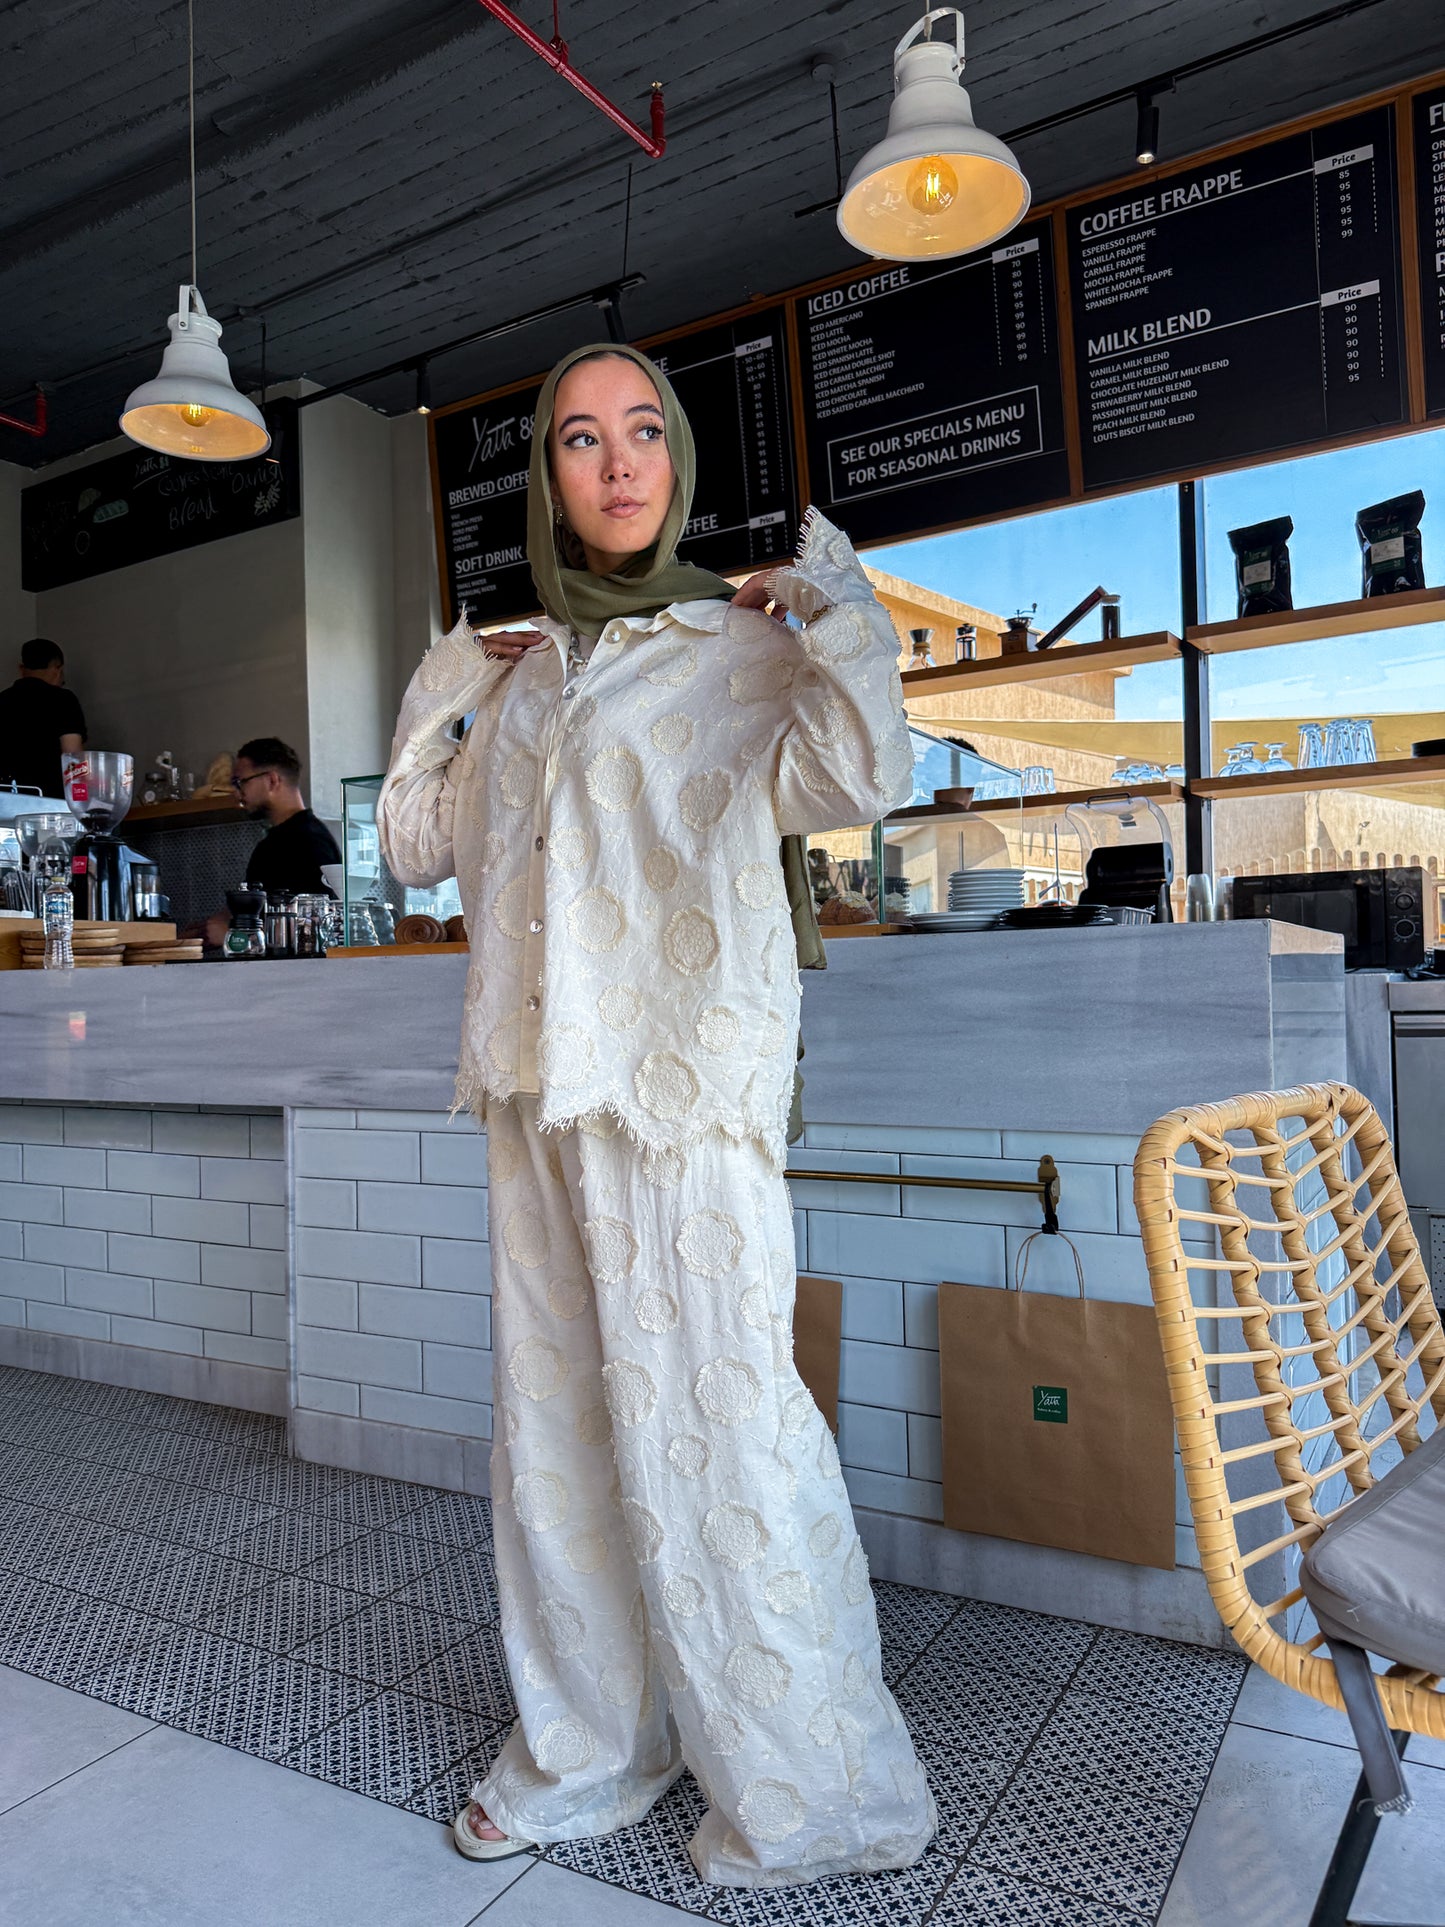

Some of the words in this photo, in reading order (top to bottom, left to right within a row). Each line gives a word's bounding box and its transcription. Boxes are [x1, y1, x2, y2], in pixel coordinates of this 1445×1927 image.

[1331, 152, 1356, 167] Price
[1339, 169, 1350, 179] 85
[1339, 181, 1350, 191] 95
[1080, 195, 1156, 236] COFFEE
[1161, 169, 1243, 211] FRAPPE
[1340, 193, 1351, 203] 95
[1340, 205, 1352, 215] 95
[1341, 216, 1352, 226] 95
[1341, 228, 1353, 238] 99
[1006, 246, 1025, 257] Price
[1082, 238, 1125, 257] ESPERESSO
[1126, 228, 1156, 243] FRAPPE
[1083, 252, 1115, 267] VANILLA
[1116, 242, 1146, 258] FRAPPE
[1083, 264, 1115, 278] CARMEL
[1116, 254, 1146, 269] FRAPPE
[1084, 275, 1114, 289] MOCHA
[1115, 265, 1145, 280] FRAPPE
[808, 290, 844, 315] ICED
[848, 267, 910, 301] COFFEE
[1085, 286, 1110, 300] WHITE
[1111, 278, 1141, 292] MOCHA
[1142, 268, 1173, 283] FRAPPE
[1337, 286, 1361, 302] Price
[1085, 295, 1118, 311] SPANISH
[1119, 286, 1149, 301] FRAPPE
[1345, 303, 1356, 313] 90
[810, 323, 824, 333] ICED
[825, 311, 863, 329] AMERICANO
[1345, 315, 1357, 325] 90
[1346, 327, 1358, 337] 90
[811, 333, 825, 342] ICED
[825, 326, 844, 338] LATTE
[812, 342, 826, 352] ICED
[826, 335, 851, 347] MOCHA
[1087, 326, 1139, 358] MILK
[1142, 307, 1212, 343] BLEND
[1346, 338, 1358, 348] 90
[746, 341, 761, 353] Price
[812, 352, 826, 362] ICED
[827, 346, 848, 357] WHITE
[848, 337, 873, 350] MOCHA
[813, 361, 827, 371] ICED
[828, 353, 855, 366] SPANISH
[856, 347, 874, 358] LATTE
[1347, 350, 1358, 360] 90
[814, 370, 828, 380] ICED
[829, 364, 851, 376] CREAM
[852, 356, 877, 369] DOUBLE
[878, 350, 896, 362] SHOT
[815, 380, 829, 390] ICED
[829, 372, 855, 385] CARMEL
[855, 361, 893, 377] MACCHIATO
[1090, 364, 1122, 378] VANILLA
[1122, 358, 1142, 370] MILK
[1144, 351, 1170, 364] BLEND
[1090, 376, 1122, 389] CARMEL
[1122, 370, 1142, 381] MILK
[1143, 362, 1169, 376] BLEND
[1347, 362, 1359, 372] 90
[815, 389, 830, 399] ICED
[830, 382, 857, 395] MATCHA
[857, 374, 885, 387] SPANISH
[1091, 384, 1136, 400] CHOCOLATE
[1180, 365, 1201, 377] MILK
[1202, 359, 1229, 372] BLEND
[1348, 373, 1360, 383] 95
[816, 399, 830, 409] ICED
[831, 388, 867, 404] CHOCOLATE
[817, 409, 831, 419] ICED
[832, 403, 854, 415] SALTED
[885, 382, 925, 400] MACCHIATO
[1091, 392, 1143, 411] STRWABERRY
[1144, 386, 1164, 398] MILK
[1165, 380, 1192, 393] BLEND
[1092, 407, 1125, 422] PASSION
[1126, 402, 1149, 414] FRUIT
[1149, 396, 1170, 408] MILK
[1171, 390, 1198, 403] BLEND
[1093, 420, 1118, 432] PEACH
[1119, 415, 1139, 426] MILK
[1140, 409, 1166, 421] BLEND
[1093, 431, 1118, 443] LOUTS
[1119, 424, 1146, 438] BISCUT
[1147, 419, 1167, 431] MILK
[1168, 413, 1195, 426] BLEND
[840, 444, 865, 465] SEE
[869, 437, 901, 457] OUR
[904, 417, 972, 448] SPECIALS
[976, 404, 1025, 430] MENU
[847, 467, 877, 486] FOR
[879, 444, 959, 478] SEASONAL
[961, 429, 1021, 457] DRINKS
[449, 480, 495, 505] BREWED
[760, 516, 775, 525] Price
[455, 556, 483, 574] SOFT
[485, 546, 523, 567] DRINK
